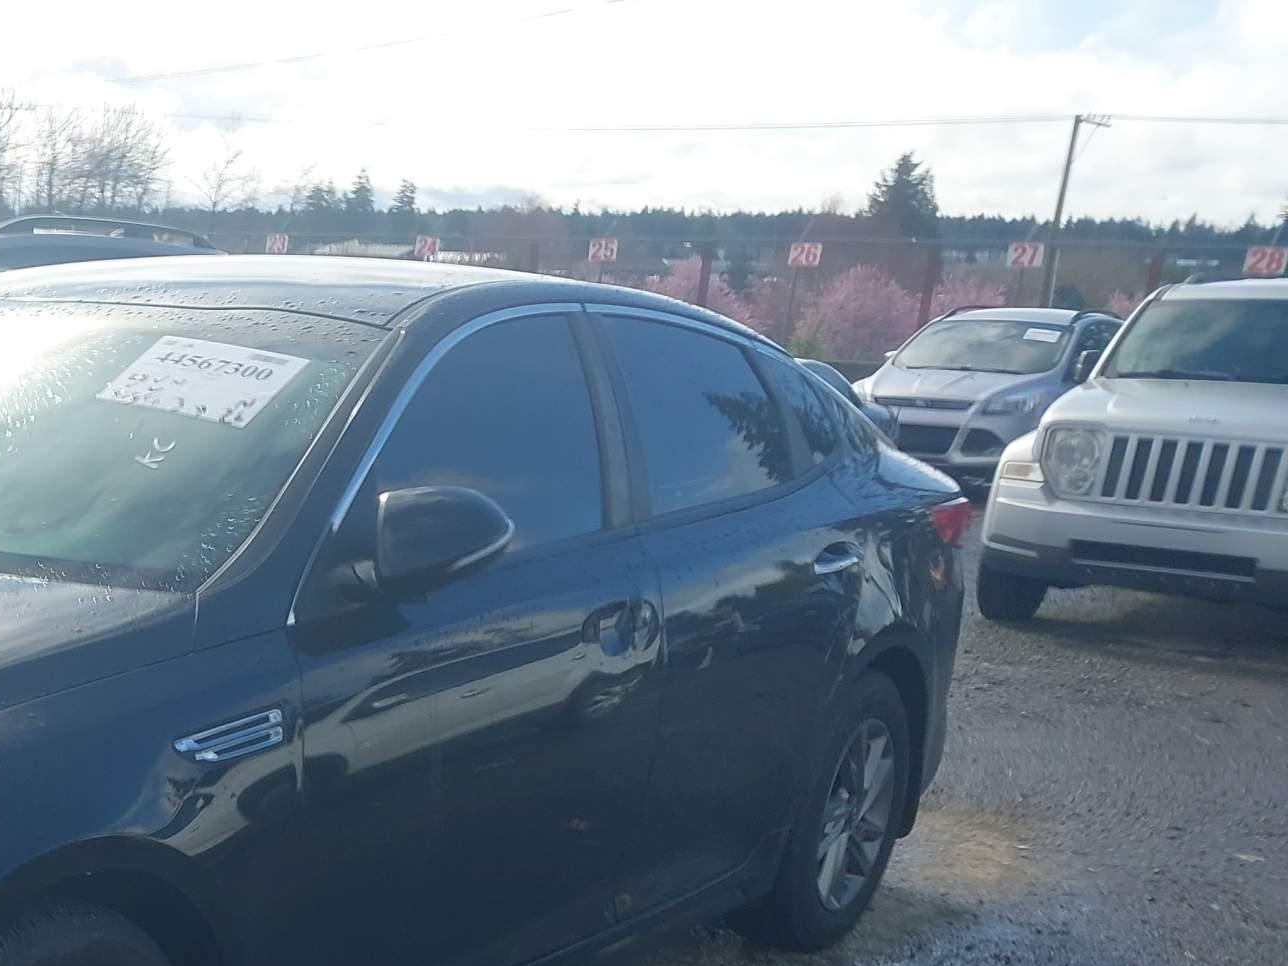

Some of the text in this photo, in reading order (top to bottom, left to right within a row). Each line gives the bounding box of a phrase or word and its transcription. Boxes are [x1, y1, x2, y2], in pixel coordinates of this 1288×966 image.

[591, 240, 615, 260] 25
[791, 244, 819, 264] 26
[1011, 244, 1040, 265] 27
[1248, 249, 1284, 273] 28
[154, 351, 274, 381] 44567300
